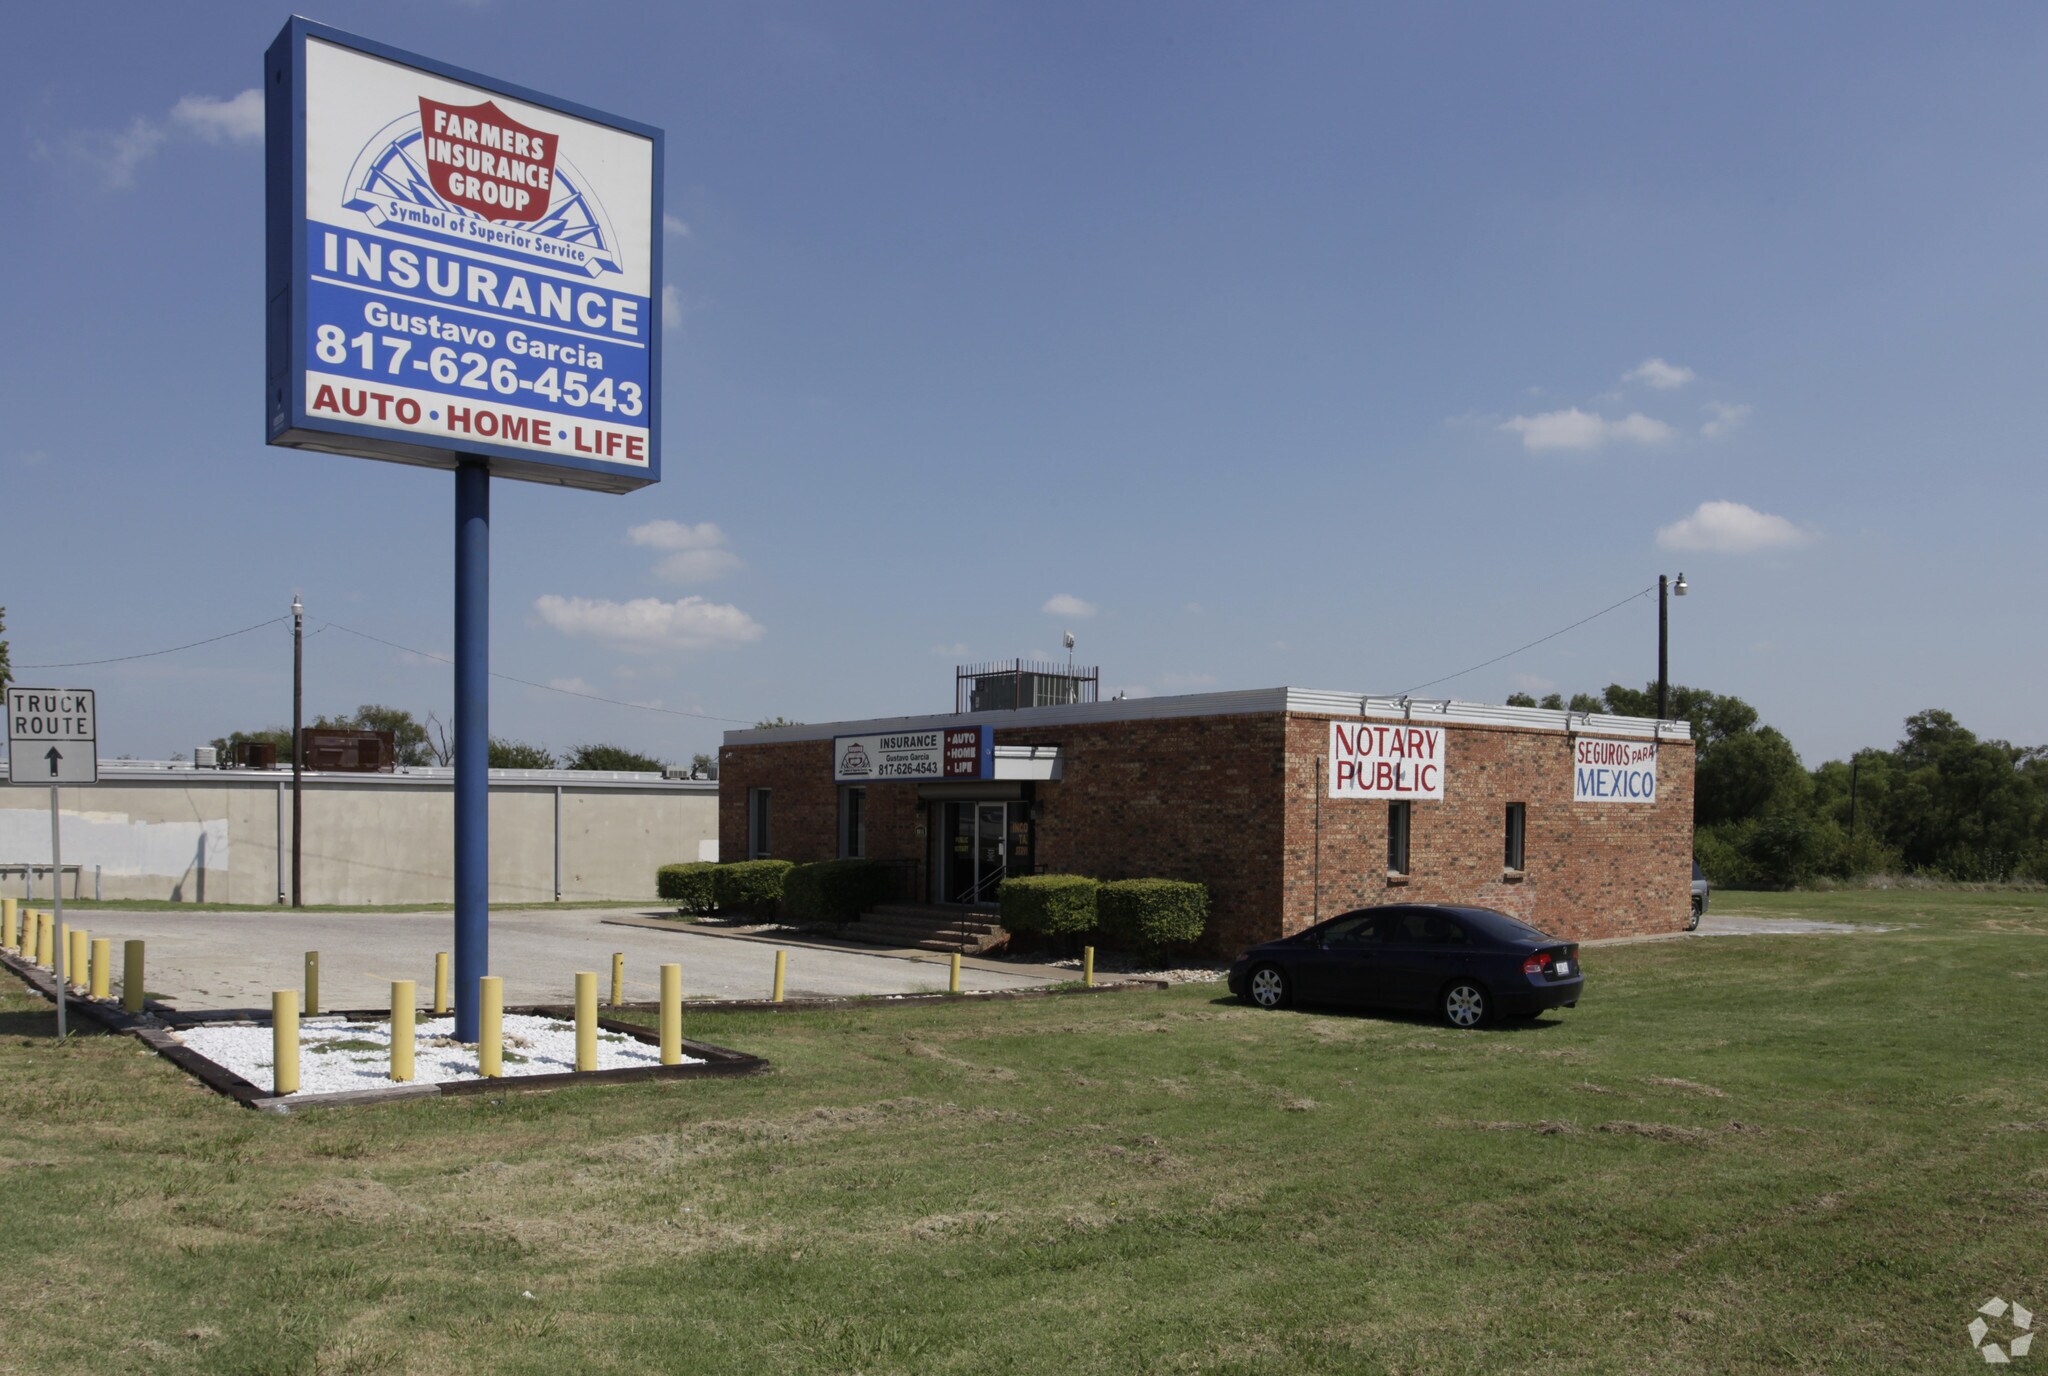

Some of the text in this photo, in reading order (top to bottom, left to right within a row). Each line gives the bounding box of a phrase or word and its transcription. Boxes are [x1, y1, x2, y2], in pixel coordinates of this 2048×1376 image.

[434, 109, 544, 160] FARMERS
[428, 137, 550, 191] INSURANCE
[448, 172, 530, 211] GROUP
[389, 201, 585, 262] Symbol of Superior Service
[323, 232, 639, 336] INSURANCE
[363, 301, 603, 370] Gustavo Garcia
[315, 324, 643, 417] 817-626-4543
[312, 384, 644, 461] AUTO HOME LIFE
[14, 695, 87, 713] TRUCK
[16, 717, 87, 734] ROUTE
[952, 733, 975, 744] AUTO
[879, 735, 937, 749] INSURANCE
[886, 753, 929, 762] Gustavo Garcia
[951, 747, 976, 759] HOME
[1335, 724, 1438, 760] NOTARY
[1577, 740, 1655, 766] SEGUROS PARA
[878, 762, 938, 776] 817-626-4543
[954, 761, 973, 773] LIFE
[1336, 761, 1438, 792] PUBLIC
[1576, 767, 1654, 798] MEXICO
